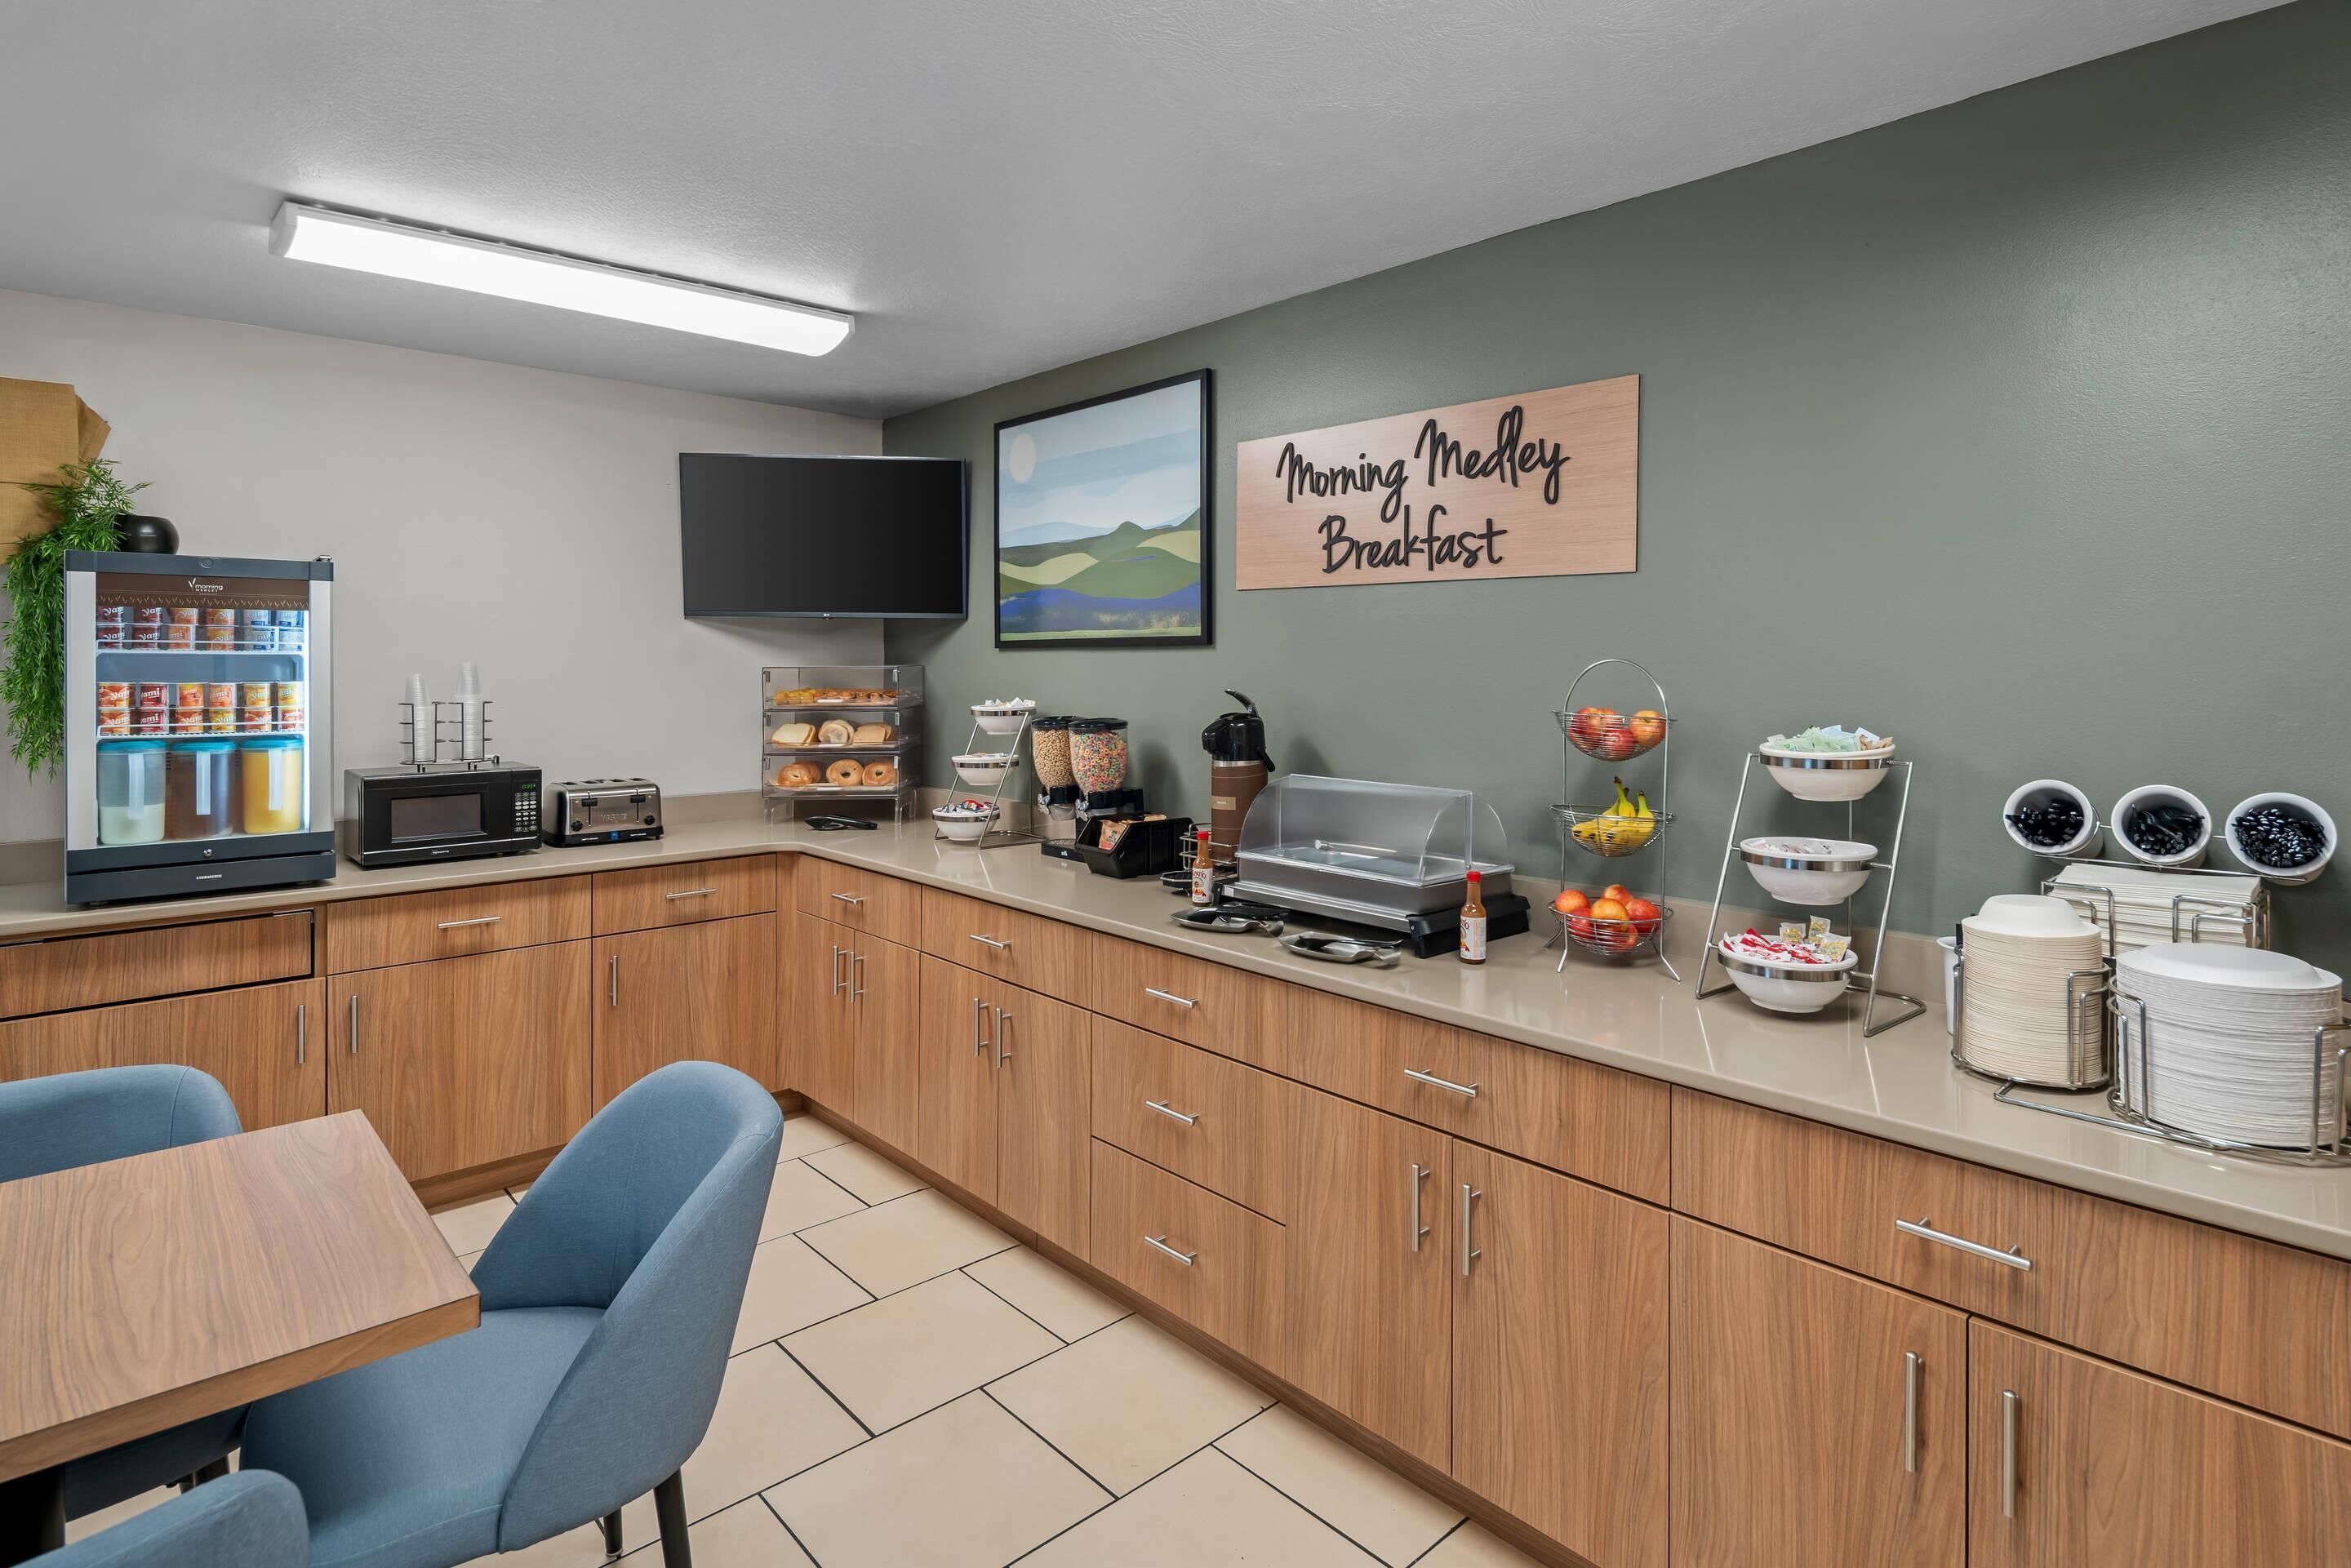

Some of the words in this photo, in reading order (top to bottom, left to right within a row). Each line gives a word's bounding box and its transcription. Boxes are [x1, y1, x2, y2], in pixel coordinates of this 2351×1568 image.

[1276, 442, 1408, 523] Morning
[1414, 406, 1571, 504] Medley
[1318, 504, 1507, 574] Breakfast
